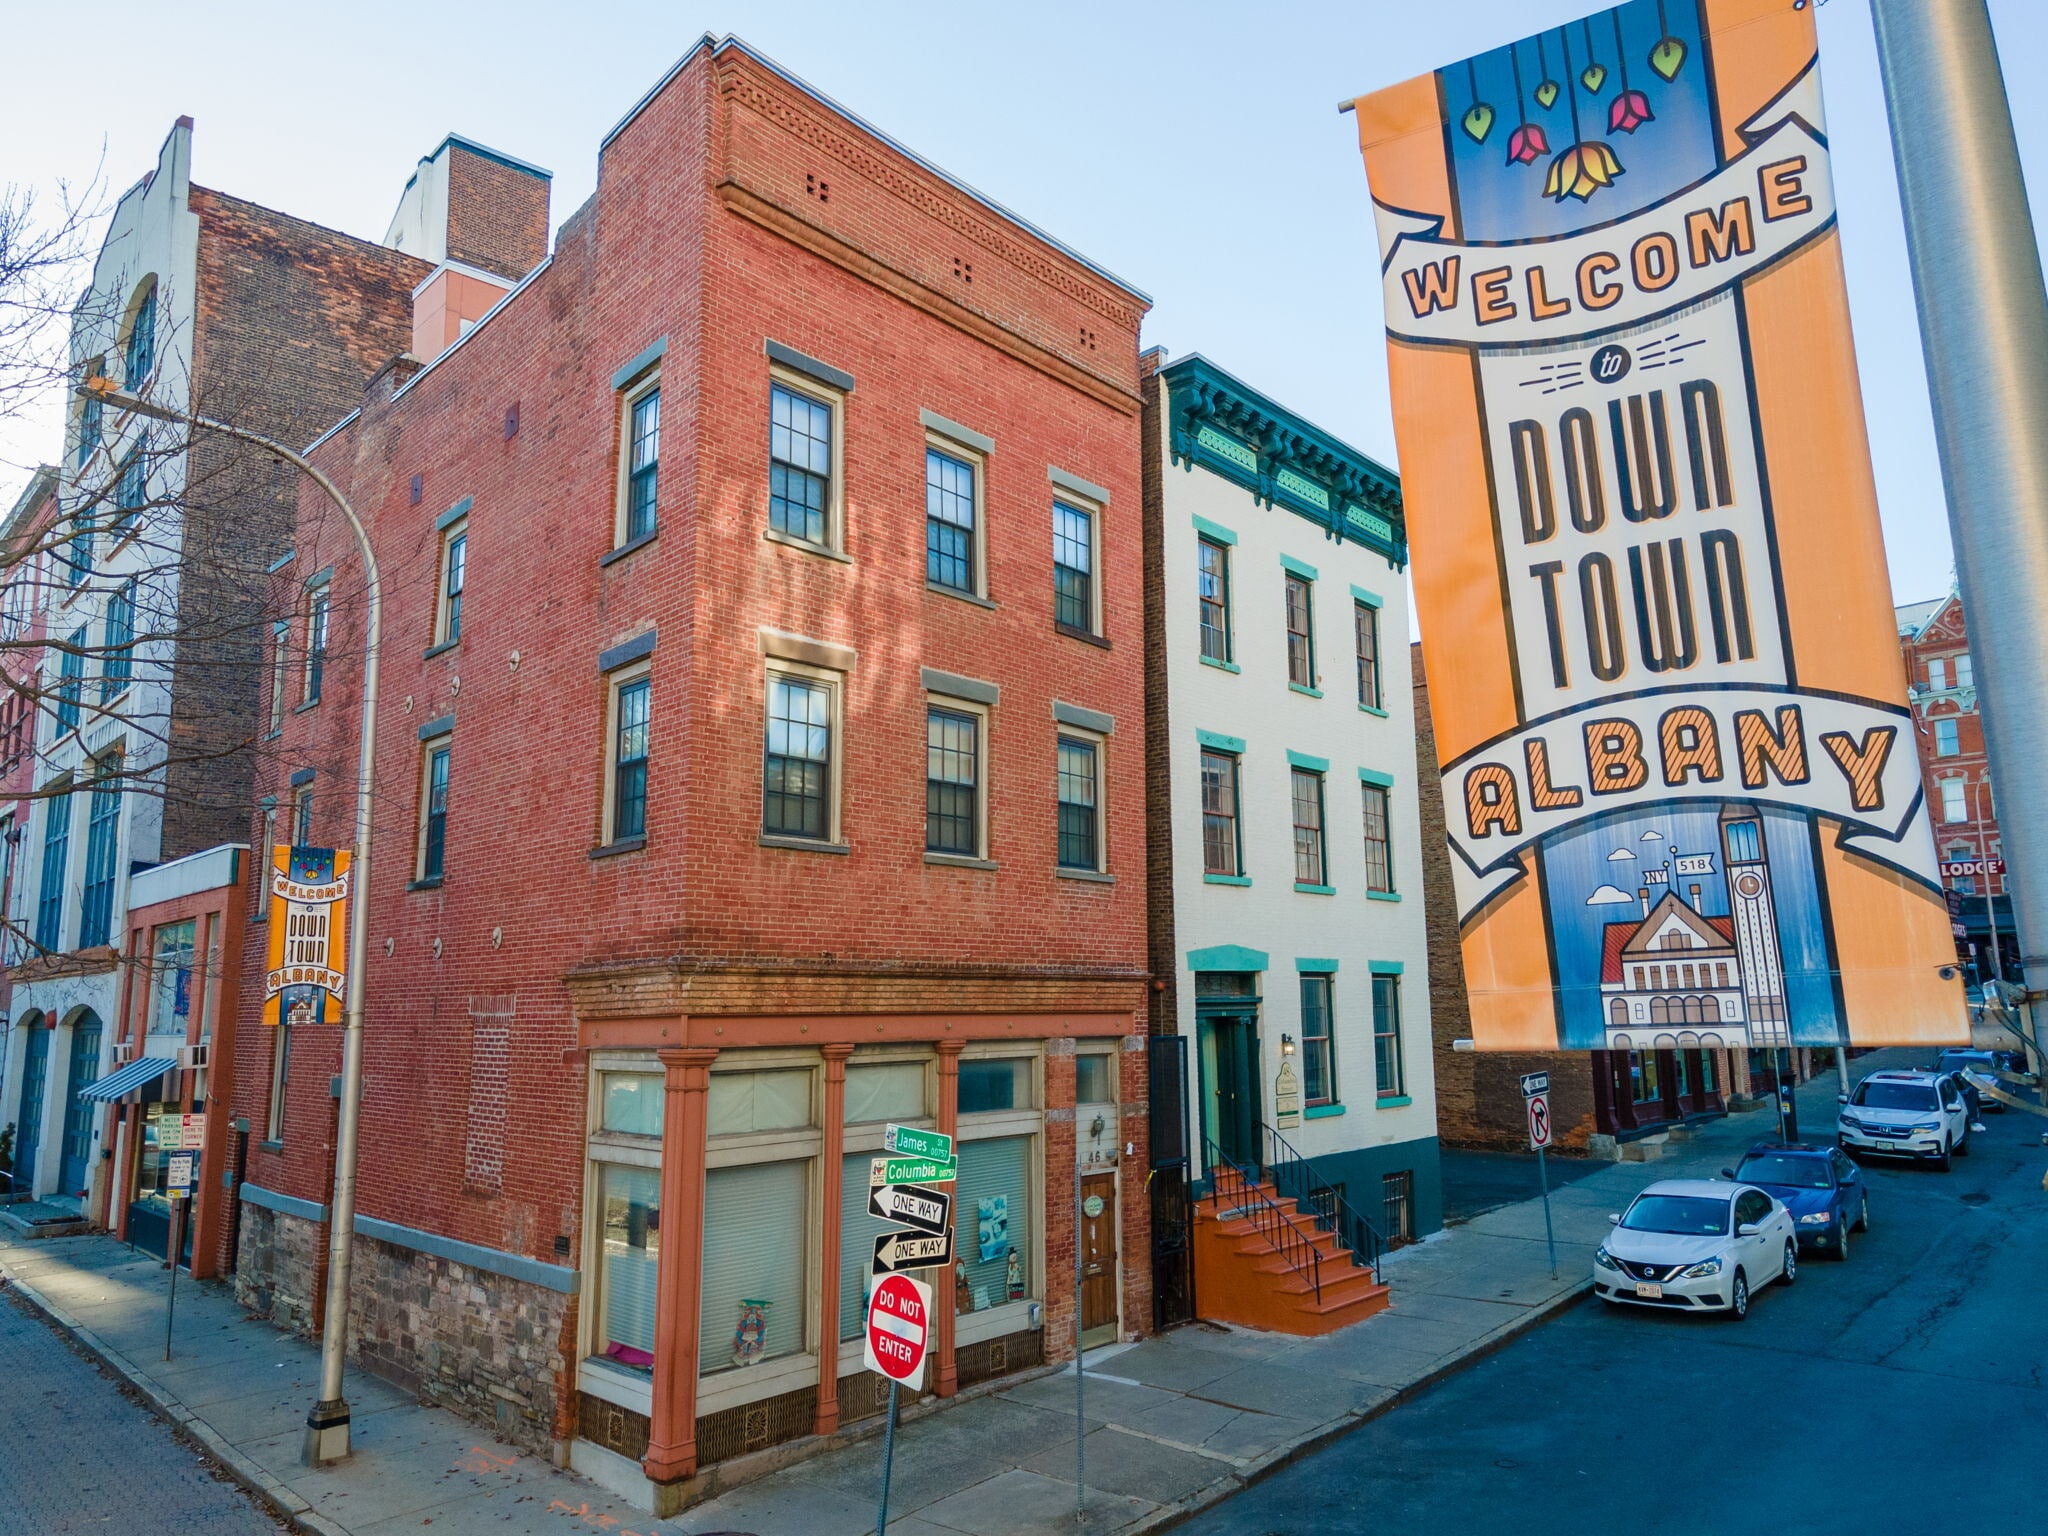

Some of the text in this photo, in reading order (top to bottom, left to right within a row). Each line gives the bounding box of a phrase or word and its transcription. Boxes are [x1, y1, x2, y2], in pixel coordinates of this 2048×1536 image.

[1402, 154, 1813, 326] WELCOME
[1600, 349, 1623, 377] to
[1508, 378, 1737, 547] DOWN
[1529, 528, 1756, 690] TOWN
[1463, 703, 1898, 838] ALBANY
[1680, 859, 1706, 871] 518
[1649, 871, 1664, 883] NY
[277, 881, 345, 899] WELCOME
[290, 914, 326, 938] DOWN
[290, 940, 325, 963] TOWN
[269, 968, 341, 989] ALBANY
[898, 1133, 928, 1152] James
[930, 1148, 948, 1158] 00757
[937, 1138, 943, 1147] St
[1088, 1151, 1101, 1163] 46
[888, 1162, 937, 1180] Columbia
[893, 1194, 940, 1220] ONE WAY
[894, 1239, 943, 1259] ONE WAY
[879, 1289, 921, 1319] DO NOT
[878, 1335, 912, 1364] ENTER
